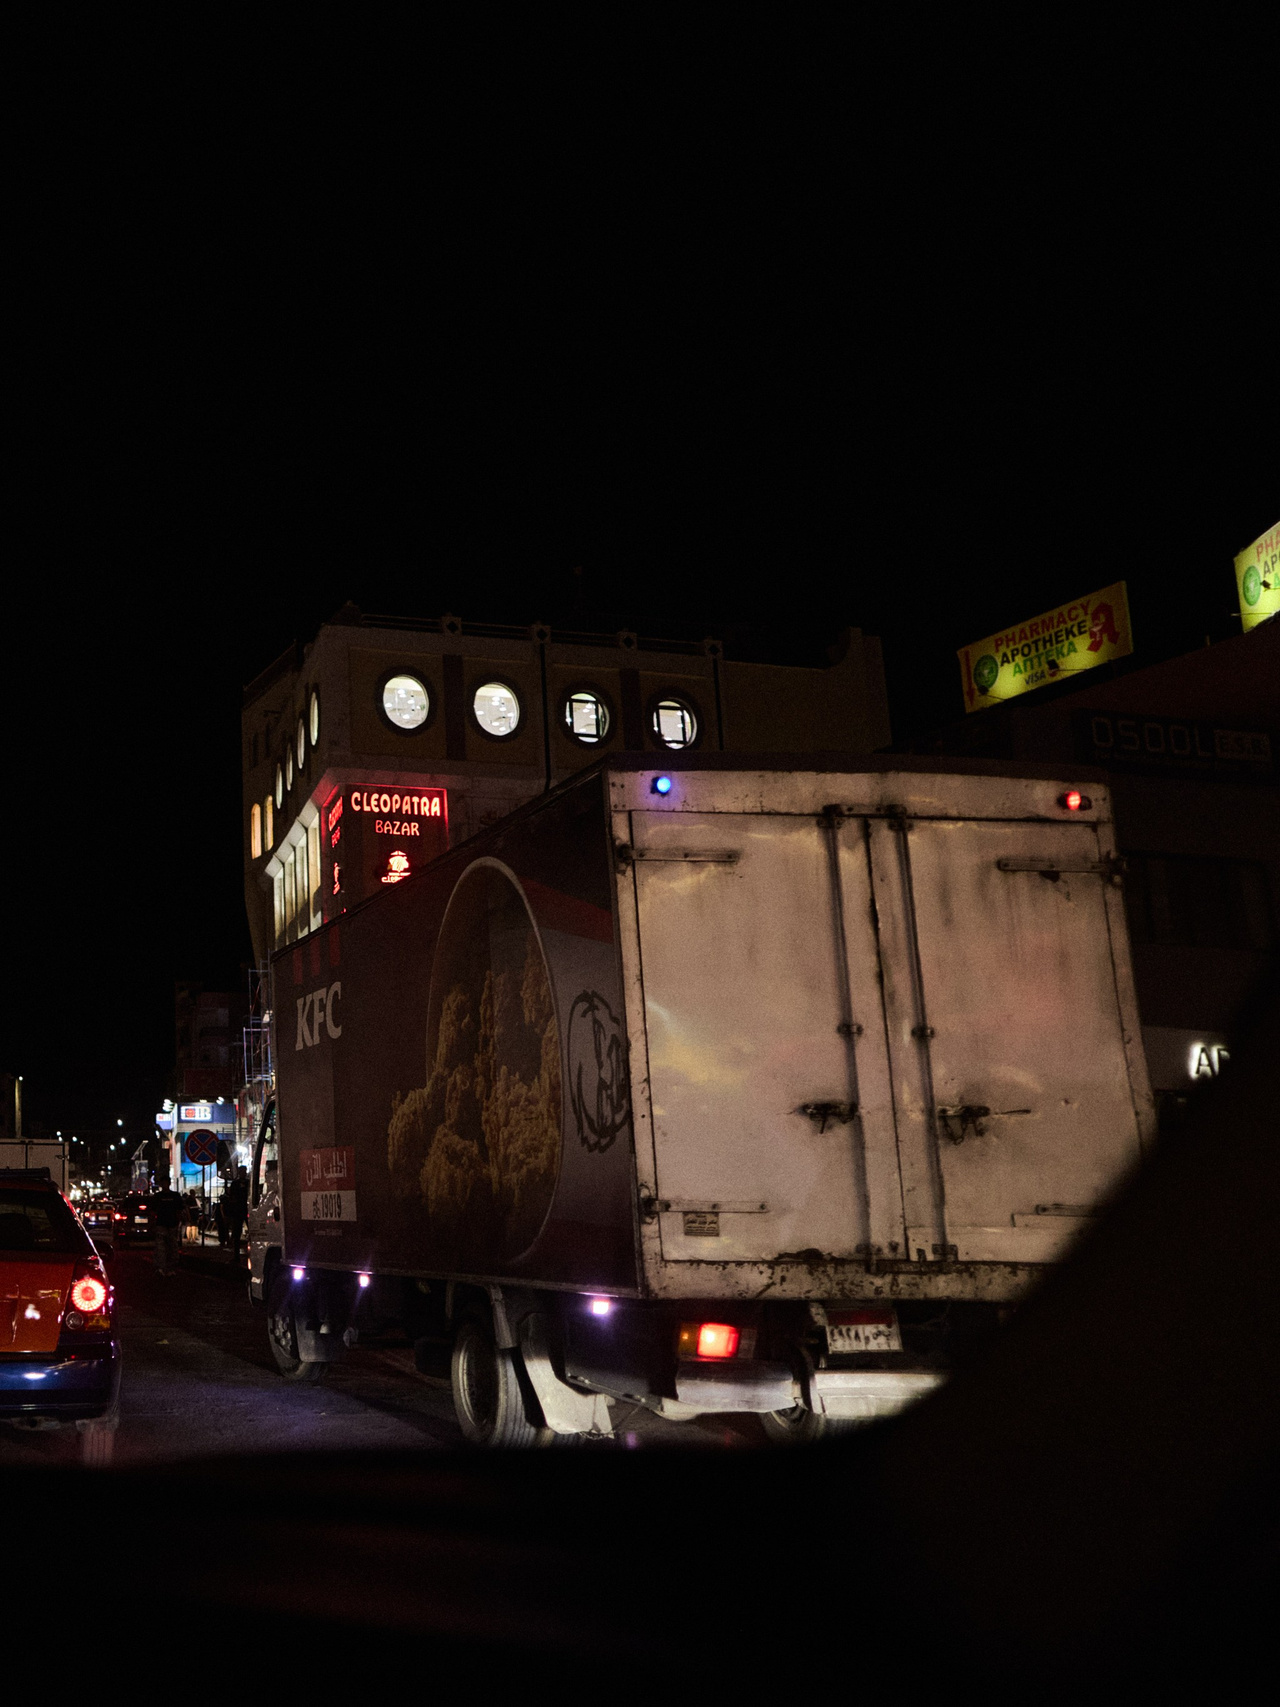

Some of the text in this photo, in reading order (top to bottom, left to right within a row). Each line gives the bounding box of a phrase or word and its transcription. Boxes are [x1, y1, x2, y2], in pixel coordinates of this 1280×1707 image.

[1264, 551, 1280, 578] AP
[994, 600, 1091, 652] PHARMACY
[1000, 619, 1088, 667] APOTHEKE
[1024, 670, 1046, 686] VISA
[351, 792, 440, 816] CLEOPATRA
[375, 820, 420, 836] BAZAR
[295, 981, 342, 1051] KFC
[321, 1193, 342, 1218] 19019
